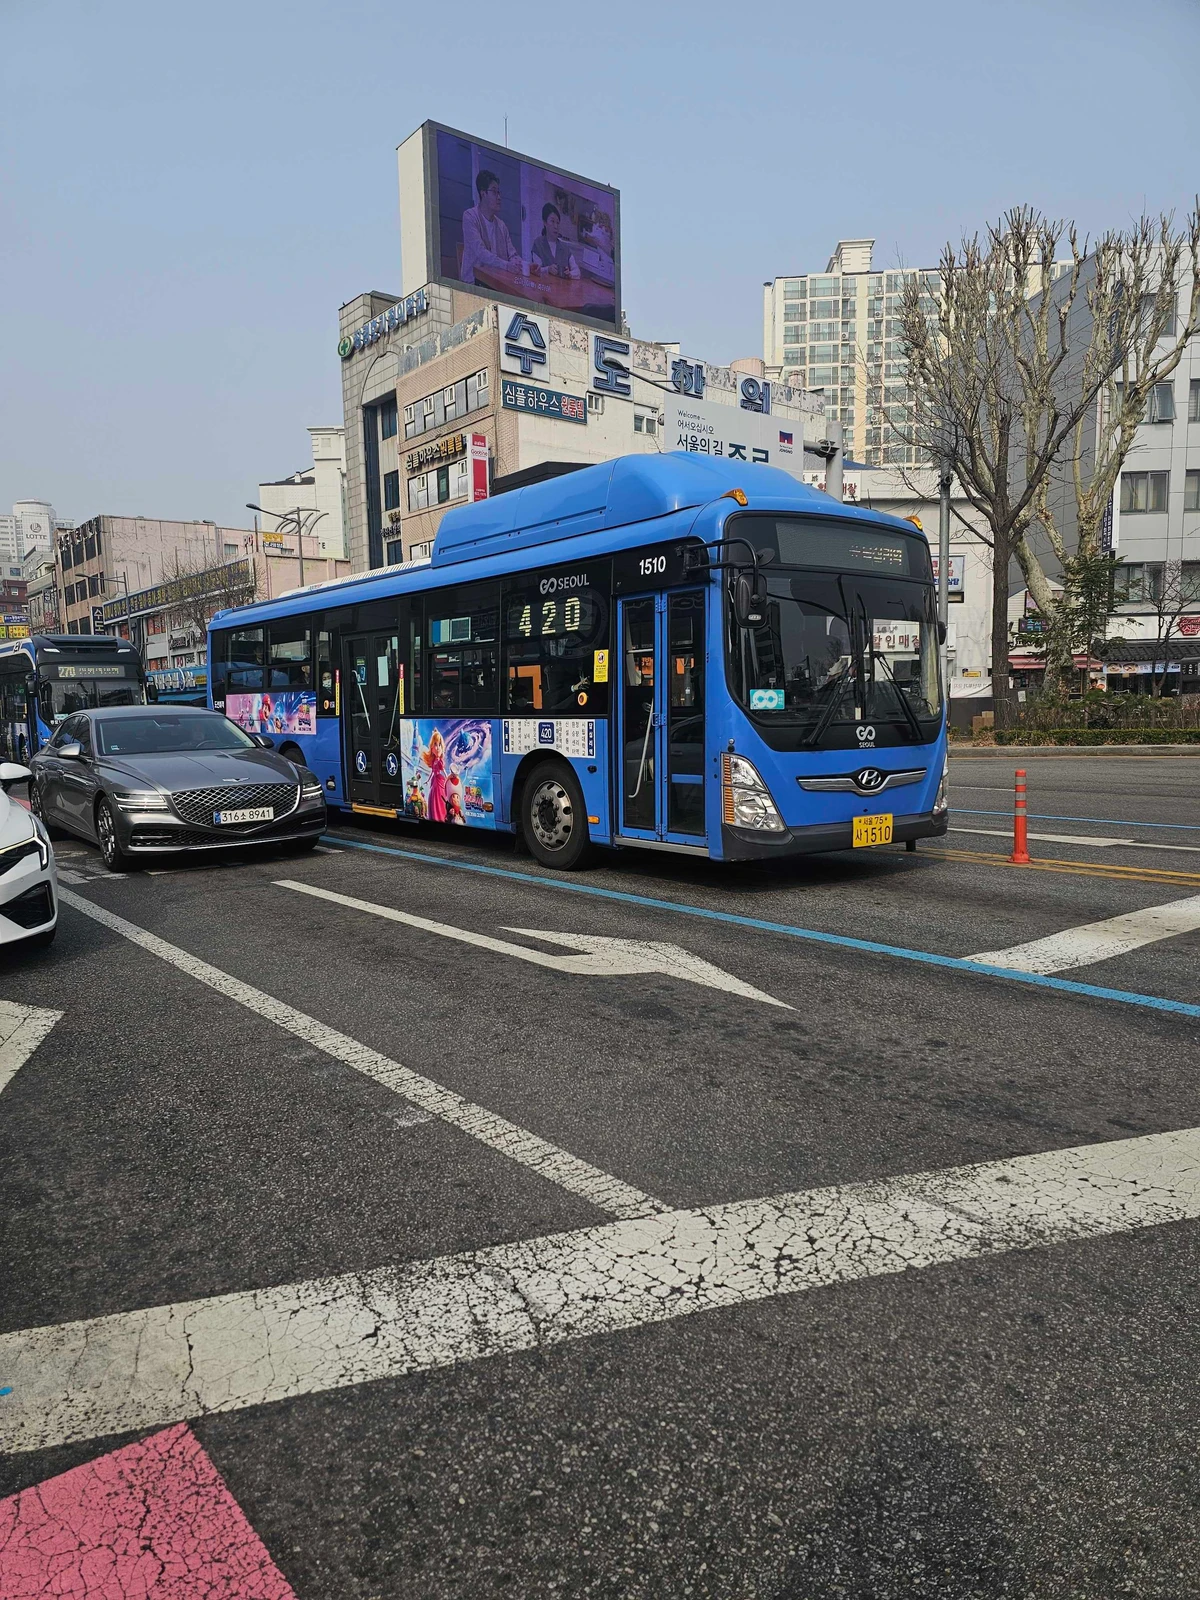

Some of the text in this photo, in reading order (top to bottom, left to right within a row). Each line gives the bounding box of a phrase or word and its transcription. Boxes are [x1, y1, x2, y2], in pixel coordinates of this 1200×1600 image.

[504, 384, 585, 419] 심플하우스 원룸텔
[677, 409, 701, 421] Welcome
[677, 419, 715, 435] 어서오십시오
[405, 443, 441, 471] 심플하우스
[639, 556, 666, 575] 1510
[558, 574, 590, 590] SEOUL
[518, 597, 580, 637] 420
[58, 666, 76, 677] 270
[541, 728, 552, 739] 420
[248, 809, 271, 819] 8941
[863, 816, 884, 825] 서울 75
[864, 825, 891, 843] 1510
